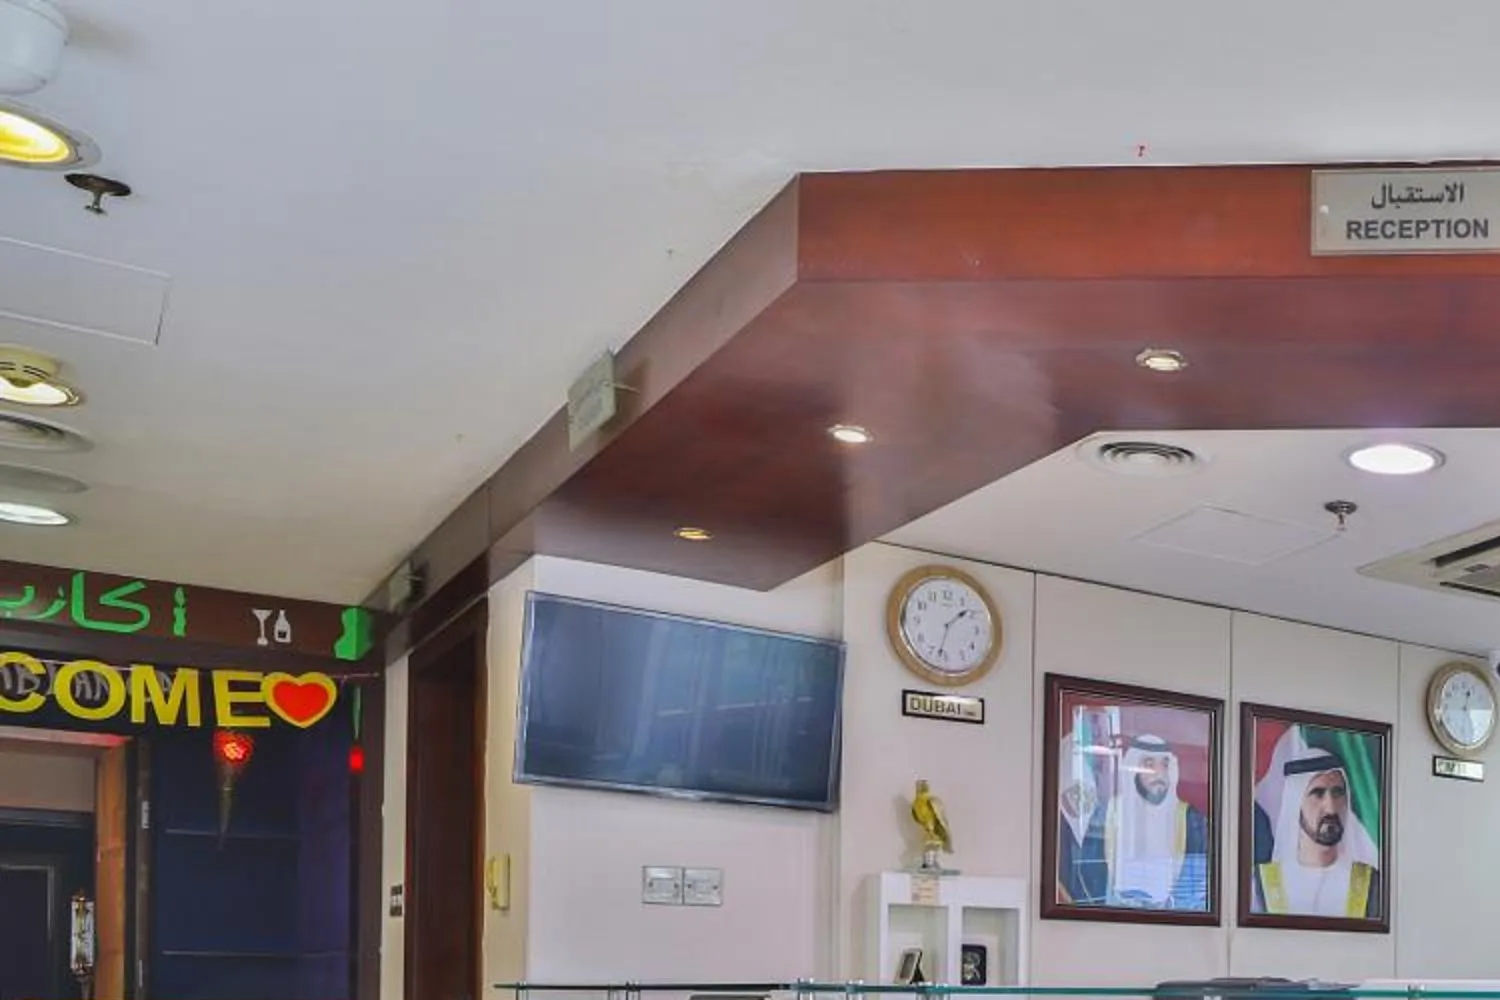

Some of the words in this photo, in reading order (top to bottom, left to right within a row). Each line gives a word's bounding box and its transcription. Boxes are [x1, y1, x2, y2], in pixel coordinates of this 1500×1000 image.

[1371, 182, 1466, 210] الاستقبال
[1346, 218, 1489, 241] RECEPTION
[909, 696, 961, 715] DUBAI
